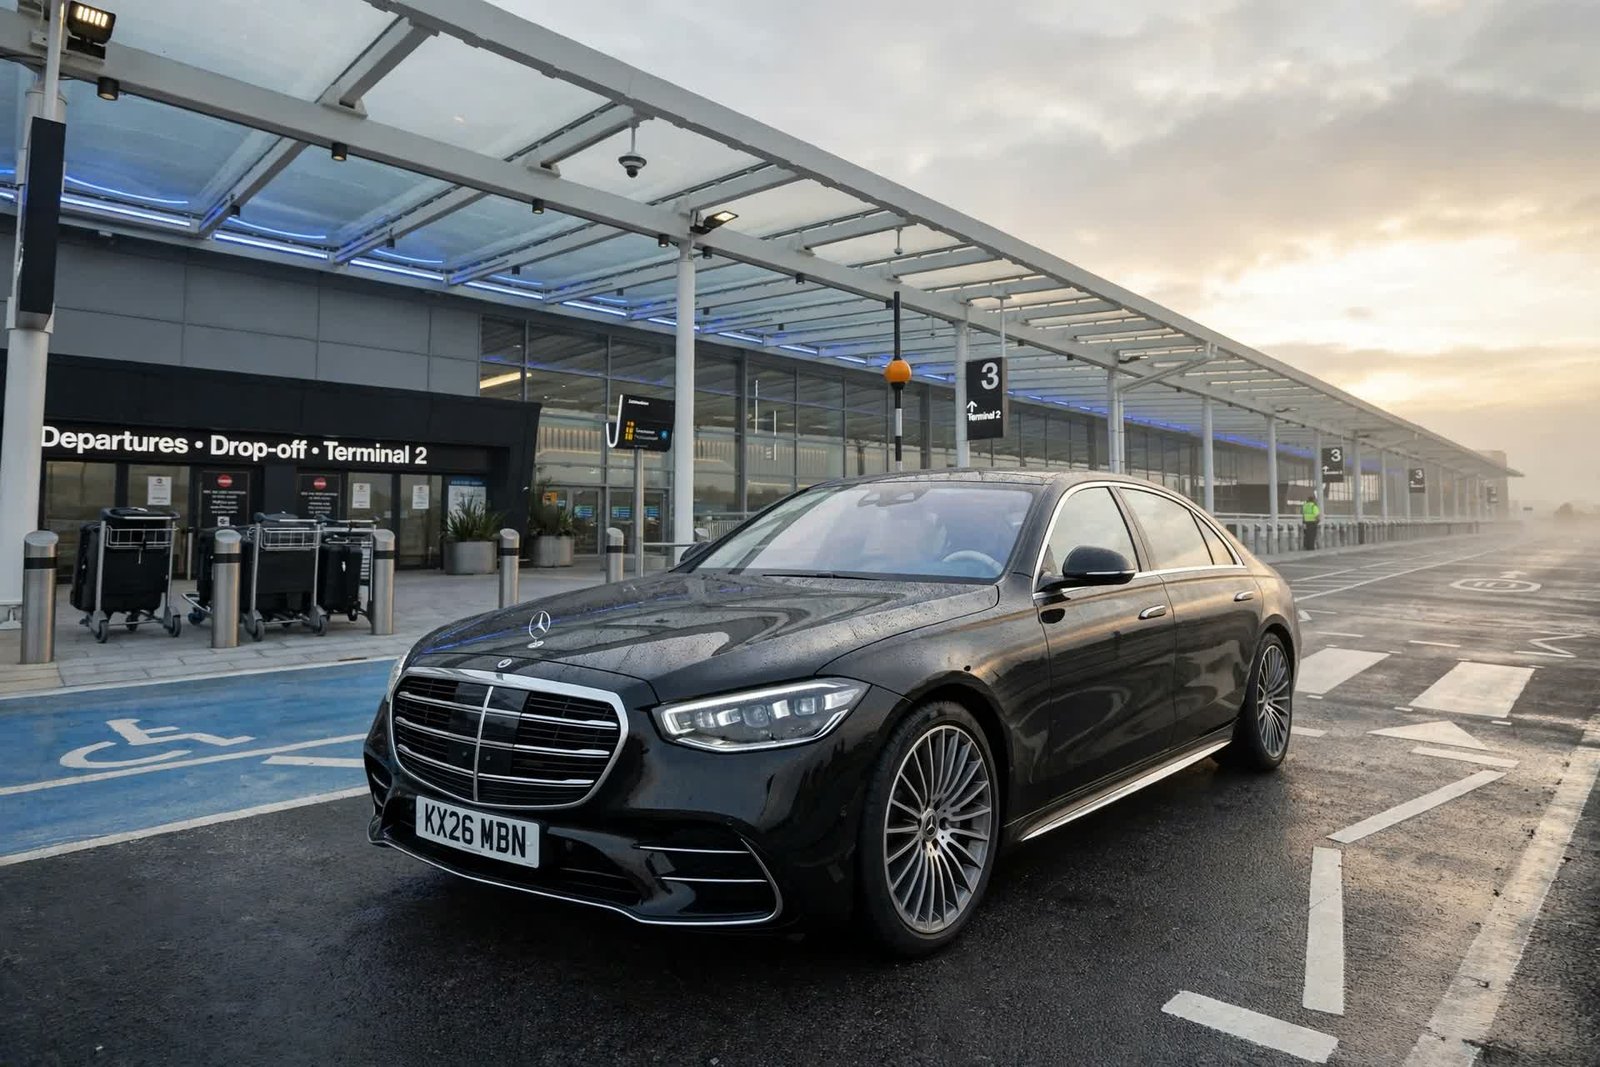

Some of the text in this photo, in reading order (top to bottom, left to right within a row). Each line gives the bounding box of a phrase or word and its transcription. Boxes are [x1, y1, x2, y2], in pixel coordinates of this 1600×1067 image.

[981, 362, 999, 390] 3
[968, 410, 1001, 421] Terminal 2
[41, 426, 428, 465] Departures Drop-off Terminal 2
[1331, 449, 1341, 461] 3
[1415, 469, 1423, 479] 3
[425, 803, 526, 858] KX26 MBN
